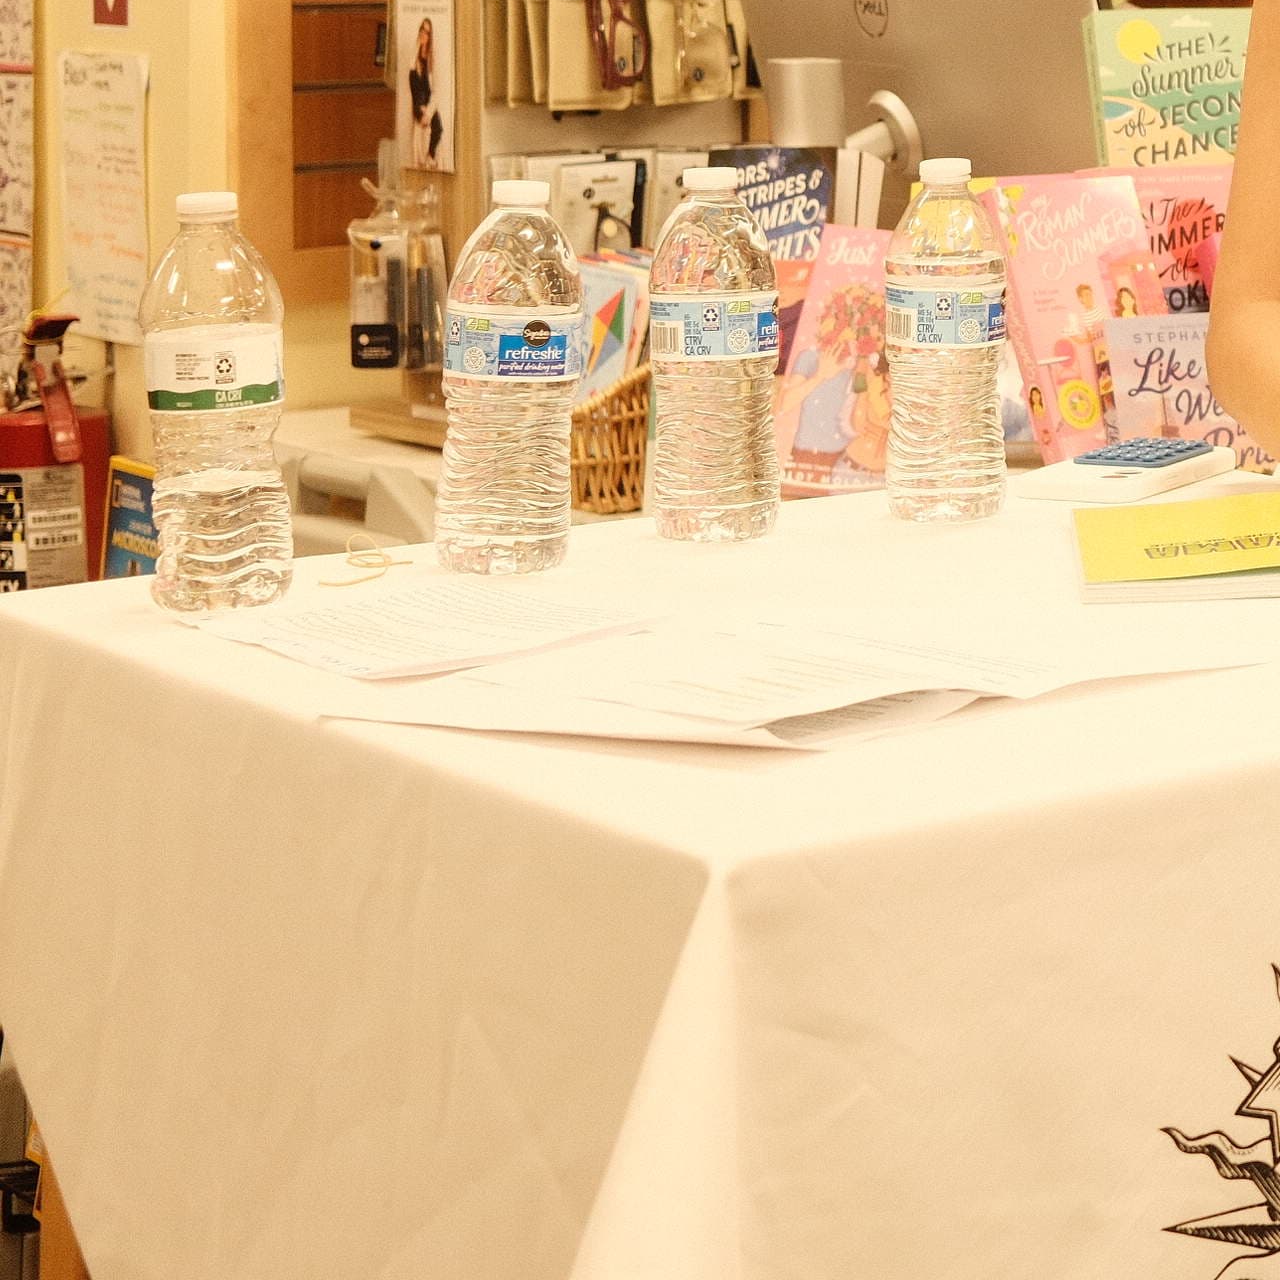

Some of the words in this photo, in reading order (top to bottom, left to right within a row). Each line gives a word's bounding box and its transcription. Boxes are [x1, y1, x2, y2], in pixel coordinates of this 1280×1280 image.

[1165, 36, 1206, 61] THE
[1132, 56, 1240, 99] Summer
[1112, 107, 1156, 138] of
[1159, 197, 1200, 227] The
[825, 236, 879, 266] Just
[1158, 248, 1200, 282] of
[1133, 330, 1206, 344] STEPHA
[1127, 346, 1202, 397] Like
